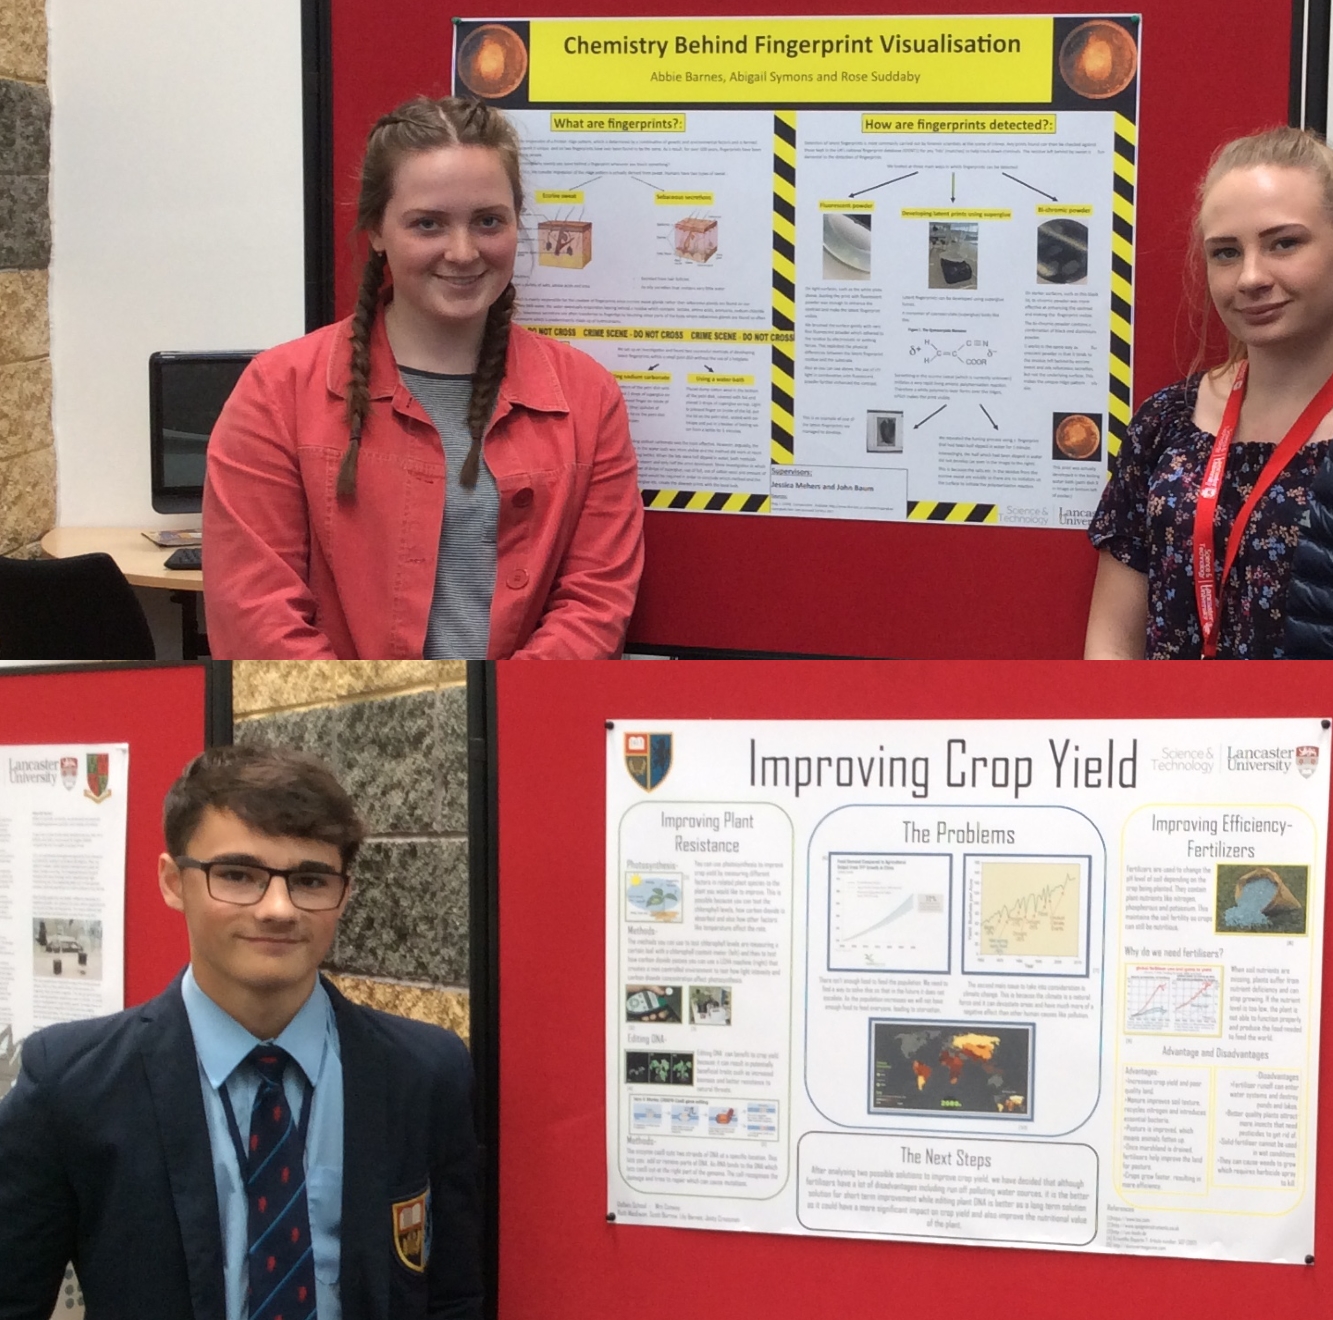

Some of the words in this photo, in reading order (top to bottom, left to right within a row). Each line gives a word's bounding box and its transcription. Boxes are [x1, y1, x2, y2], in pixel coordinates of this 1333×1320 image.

[564, 34, 668, 57] Chemistry
[674, 34, 748, 54] Behind
[755, 34, 874, 57] Fingerprint
[879, 33, 1022, 54] Visualisation
[650, 70, 683, 83] Abbie
[685, 70, 727, 84] Barnes,
[729, 70, 767, 85] Abigail
[769, 71, 814, 85] Symons
[816, 70, 838, 83] and
[841, 71, 869, 83] Rose
[871, 70, 921, 85] Suddaby
[553, 117, 584, 129] What
[586, 120, 605, 129] are
[608, 117, 683, 132] fingerprints?:
[865, 118, 893, 131] How
[897, 121, 914, 131] are
[917, 118, 986, 133] fingerprints
[989, 118, 1054, 132] detected?:
[852, 202, 873, 210] powder
[1068, 207, 1091, 215] powder
[901, 210, 931, 218] Developing
[932, 210, 949, 218] latent
[950, 211, 967, 219] prints
[539, 328, 552, 337] NOT
[554, 328, 576, 337] CROSS
[583, 328, 605, 338] CRIME
[606, 328, 628, 338] SCENE
[633, 329, 644, 339] DO
[645, 330, 660, 339] NOT
[661, 330, 683, 339] CROSS
[691, 331, 711, 340] CRIME
[713, 331, 736, 341] SCENE
[742, 332, 753, 341] DO
[754, 332, 769, 342] NOT
[770, 332, 795, 342] CROSS
[696, 376, 711, 384] Using
[771, 467, 813, 478] Supervisors:
[771, 481, 795, 490] Jessica
[797, 481, 821, 491] Mehers
[823, 483, 835, 491] and
[837, 483, 853, 492] John
[854, 484, 874, 492] Baum
[1007, 505, 1040, 516] Science
[1041, 506, 1049, 516] &
[1058, 506, 1097, 519] Lancas
[998, 514, 1049, 526] Technology
[1161, 748, 1204, 760] Science
[1205, 748, 1214, 760] &
[1226, 746, 1294, 760] Lancaster
[9, 758, 59, 773] Lancaster
[750, 739, 929, 798] Improving
[946, 739, 1032, 799] Crop
[1048, 738, 1138, 789] Yield
[1151, 758, 1214, 774] Technology
[1226, 759, 1293, 774] University
[9, 770, 57, 786] University
[661, 811, 720, 832] Improving
[724, 811, 754, 829] Plant
[1152, 814, 1218, 836] Improving
[1222, 814, 1293, 836] Efficiency-
[902, 821, 930, 843] The
[936, 821, 1015, 845] Problems
[675, 835, 740, 853] Resistance
[1187, 840, 1255, 858] Fertilizers
[1124, 946, 1140, 958] Why
[1141, 947, 1151, 957] do
[1151, 949, 1162, 958] we
[1163, 947, 1182, 958] need
[1182, 947, 1224, 959] fertilisers?
[627, 1033, 650, 1045] Editing
[1162, 1046, 1200, 1059] Advantage
[1201, 1047, 1215, 1058] and
[1216, 1047, 1270, 1060] Disadvantages
[900, 1146, 922, 1165] The
[925, 1148, 953, 1166] Next
[956, 1149, 992, 1168] Steps
